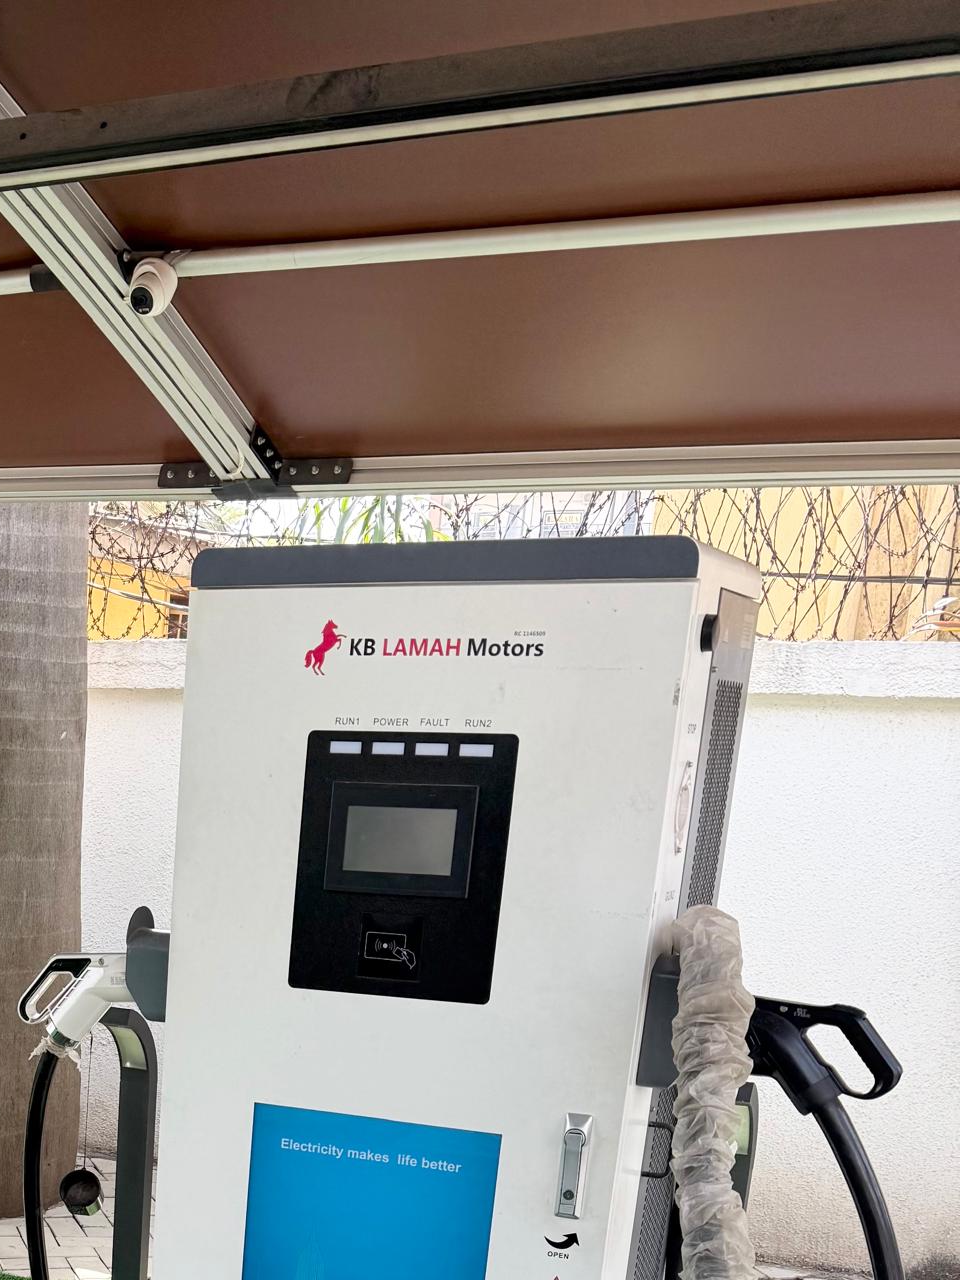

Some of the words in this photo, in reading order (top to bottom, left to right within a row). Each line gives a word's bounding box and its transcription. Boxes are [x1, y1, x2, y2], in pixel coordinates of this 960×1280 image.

[348, 638, 377, 657] KB
[382, 638, 462, 657] LAMAH
[466, 638, 545, 657] Motors
[334, 716, 360, 726] RUN1
[373, 717, 410, 727] POWER
[419, 717, 451, 728] FAULT
[464, 718, 493, 728] RUN2
[280, 1138, 344, 1159] Electricity
[347, 1149, 390, 1163] makes
[397, 1154, 418, 1167] life
[421, 1157, 462, 1173] better
[547, 1250, 570, 1260] OPEN
